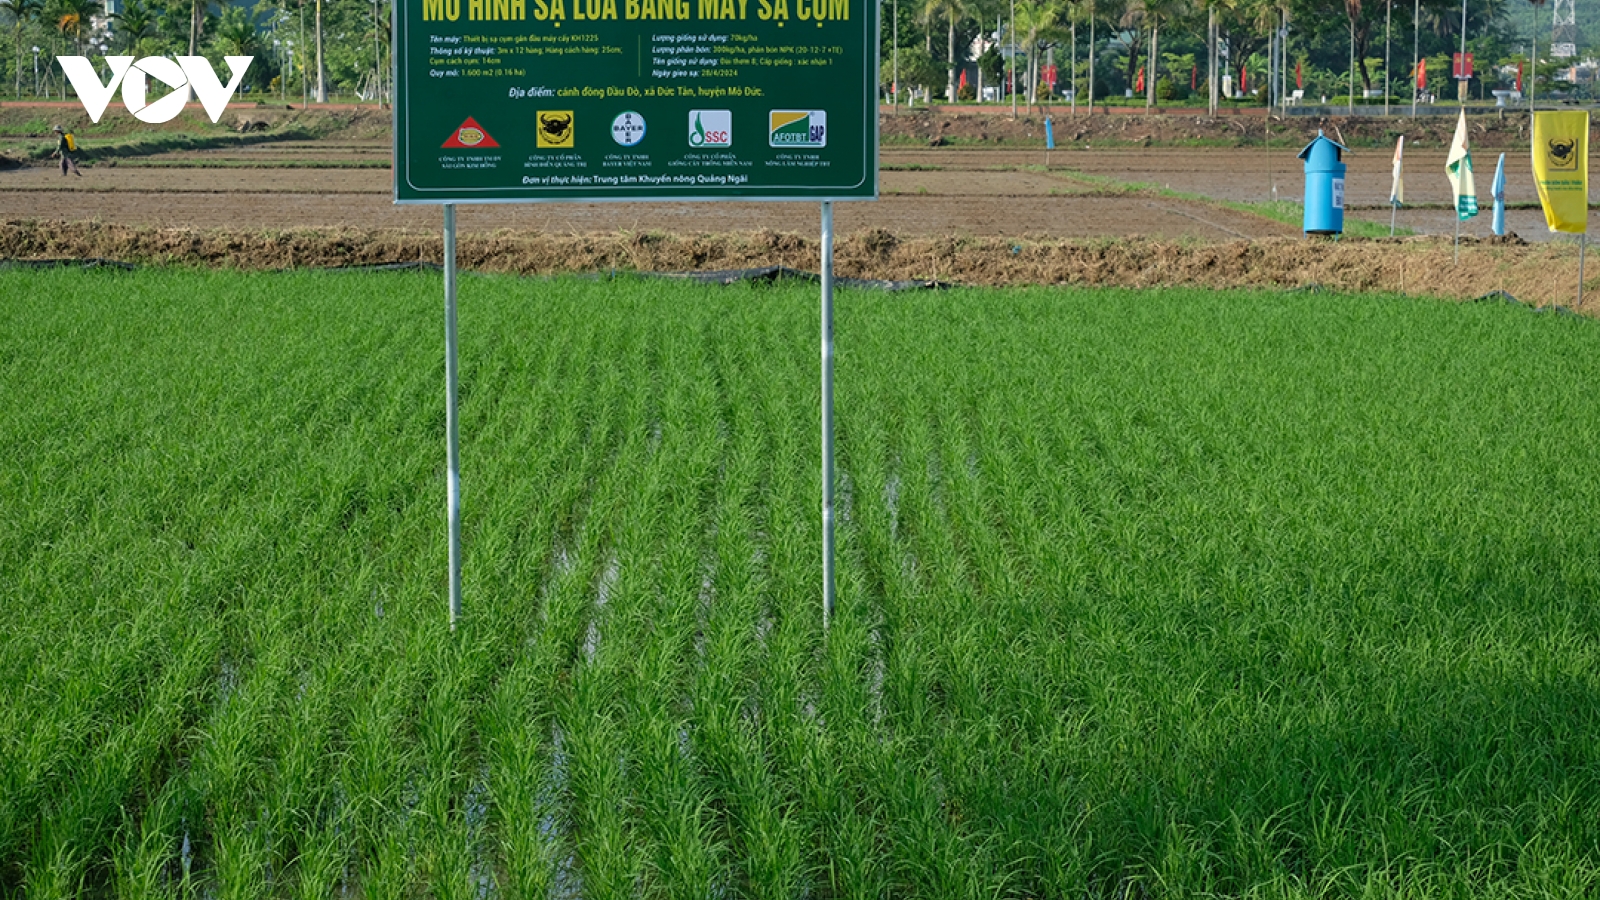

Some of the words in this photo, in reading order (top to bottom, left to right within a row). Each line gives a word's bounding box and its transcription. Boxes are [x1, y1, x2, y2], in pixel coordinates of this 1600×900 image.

[731, 34, 758, 43] 70kg/ha
[497, 46, 508, 56] 3m
[516, 46, 524, 56] 12
[779, 46, 794, 55] NPK
[482, 57, 501, 65] 14cm
[702, 69, 739, 78] 28/4/2024
[509, 86, 525, 98] Địa
[527, 86, 555, 98] điểm:
[557, 86, 579, 98] cánh
[657, 86, 674, 98] Đức
[677, 86, 696, 98] Tân,
[698, 86, 726, 98] huyện
[744, 86, 765, 98] Đức.
[705, 131, 728, 143] SSC
[773, 133, 807, 142] AFOTBT
[810, 125, 825, 142] GAP
